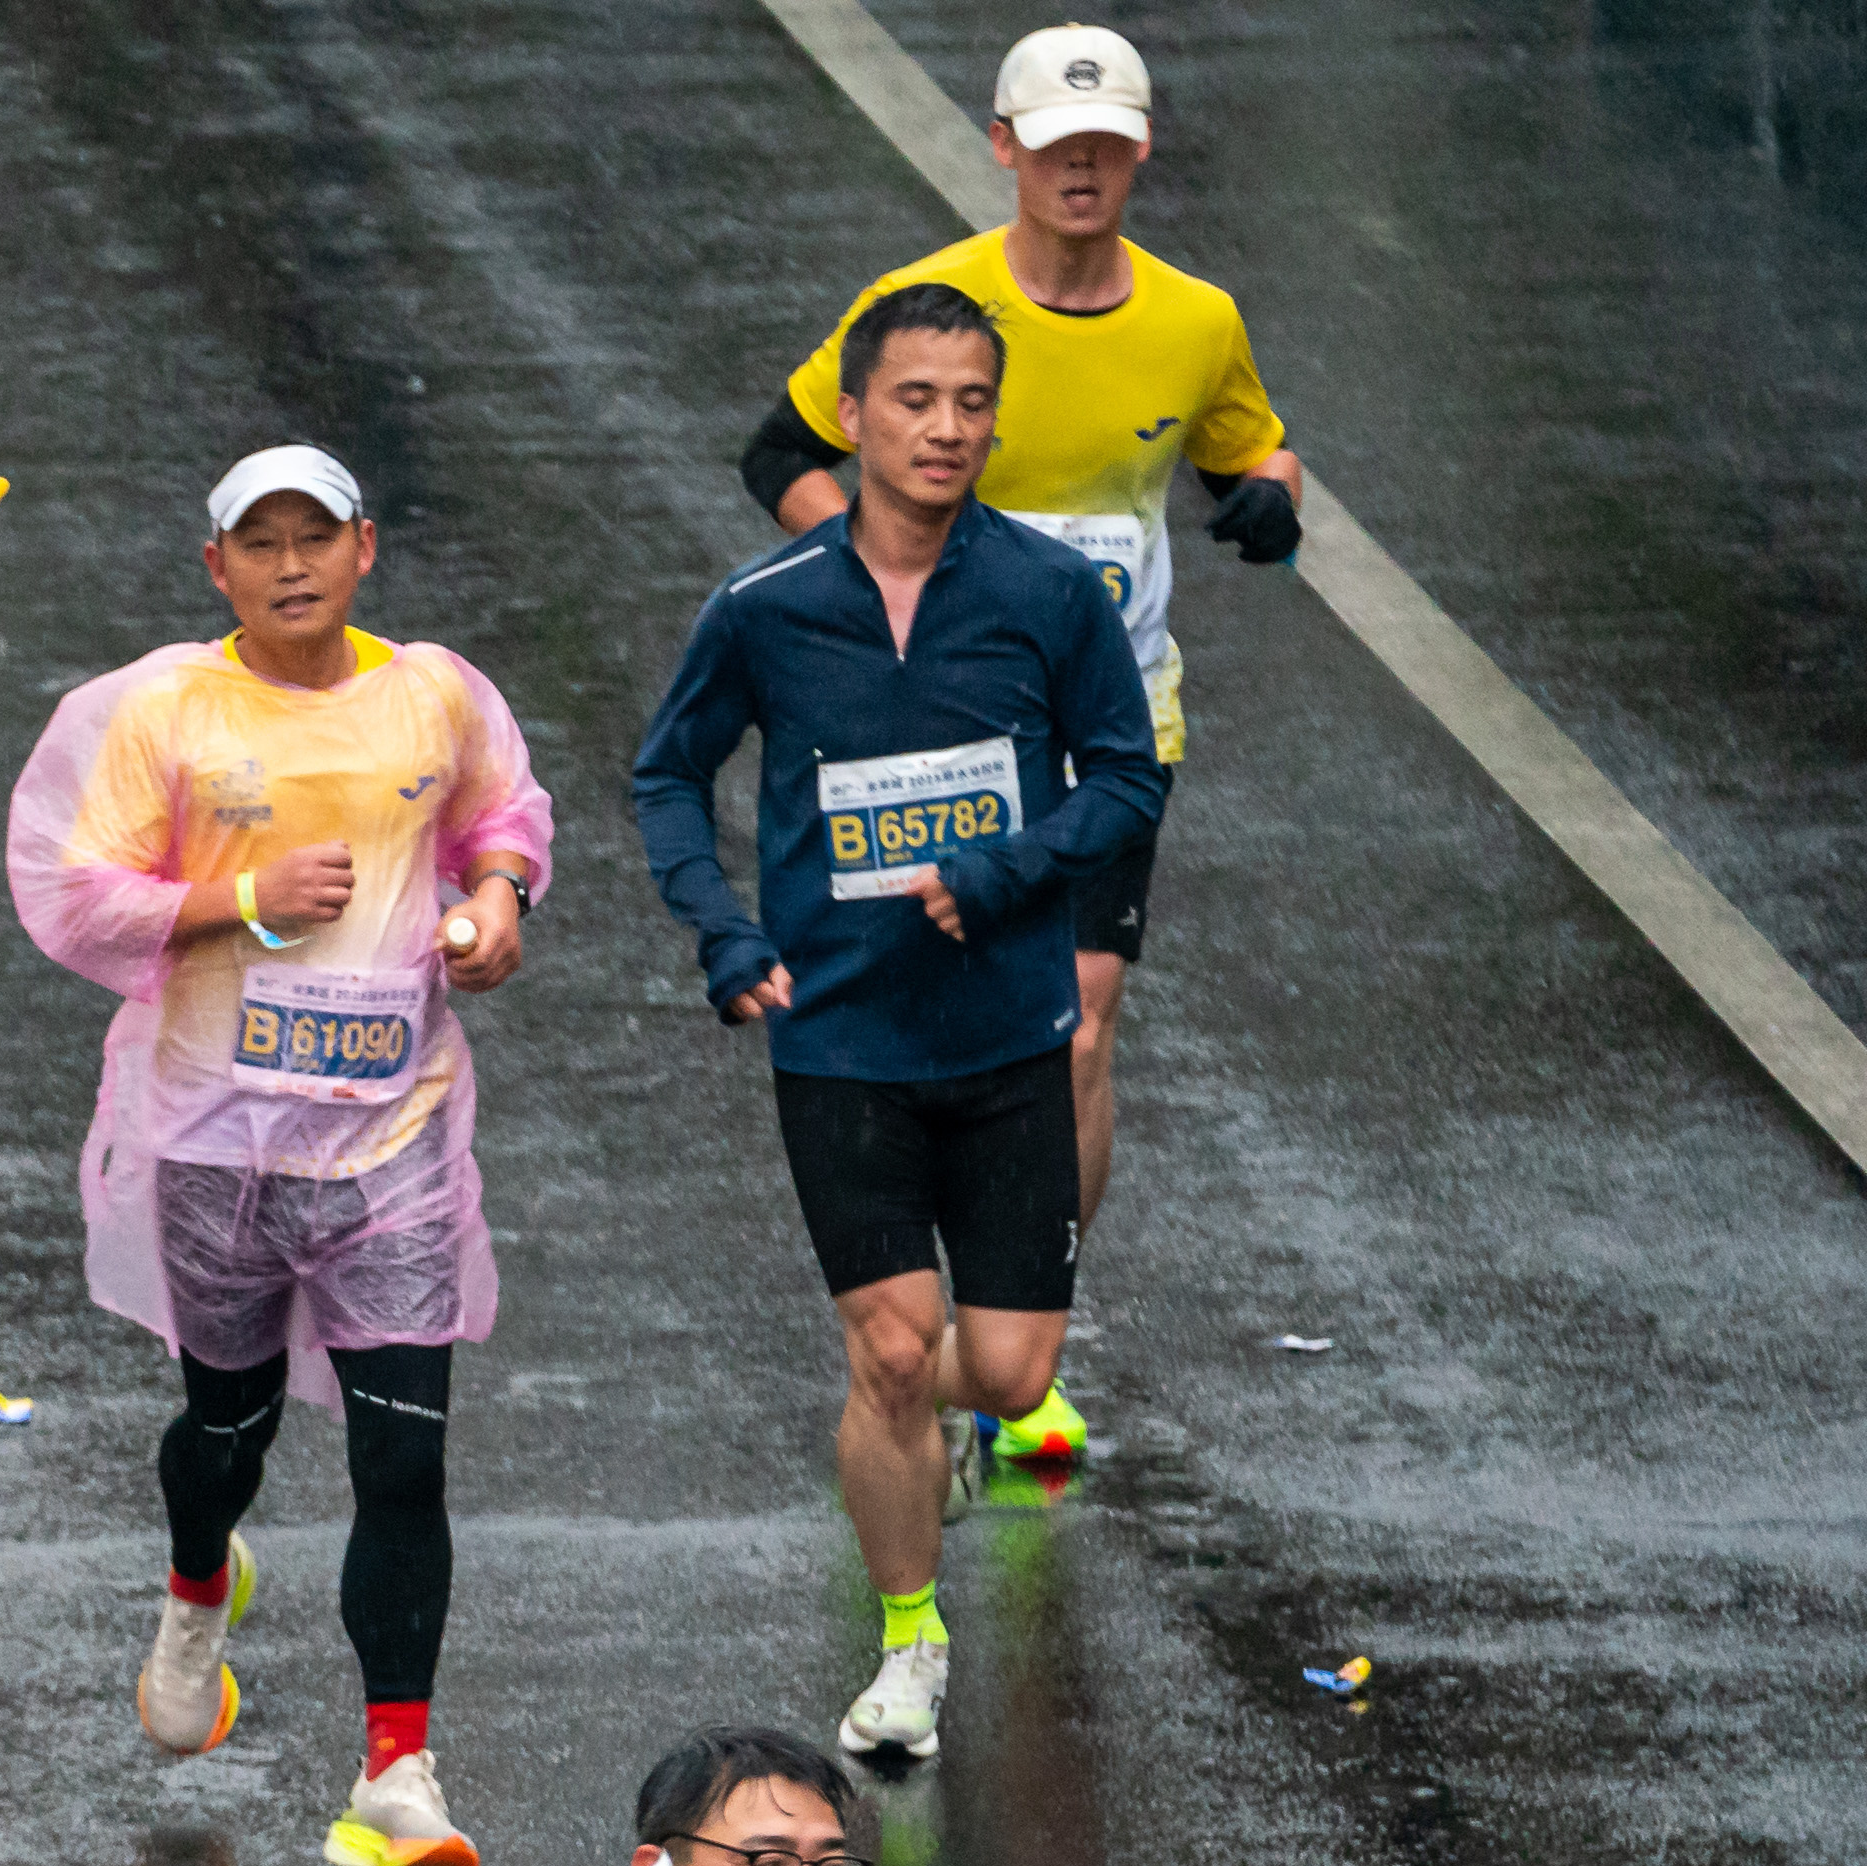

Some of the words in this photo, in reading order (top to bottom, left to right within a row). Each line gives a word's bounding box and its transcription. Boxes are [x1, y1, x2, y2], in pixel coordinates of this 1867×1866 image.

[829, 814, 868, 860] B
[878, 795, 1000, 850] 65782
[243, 1007, 279, 1054] B
[292, 1016, 404, 1061] 61090
